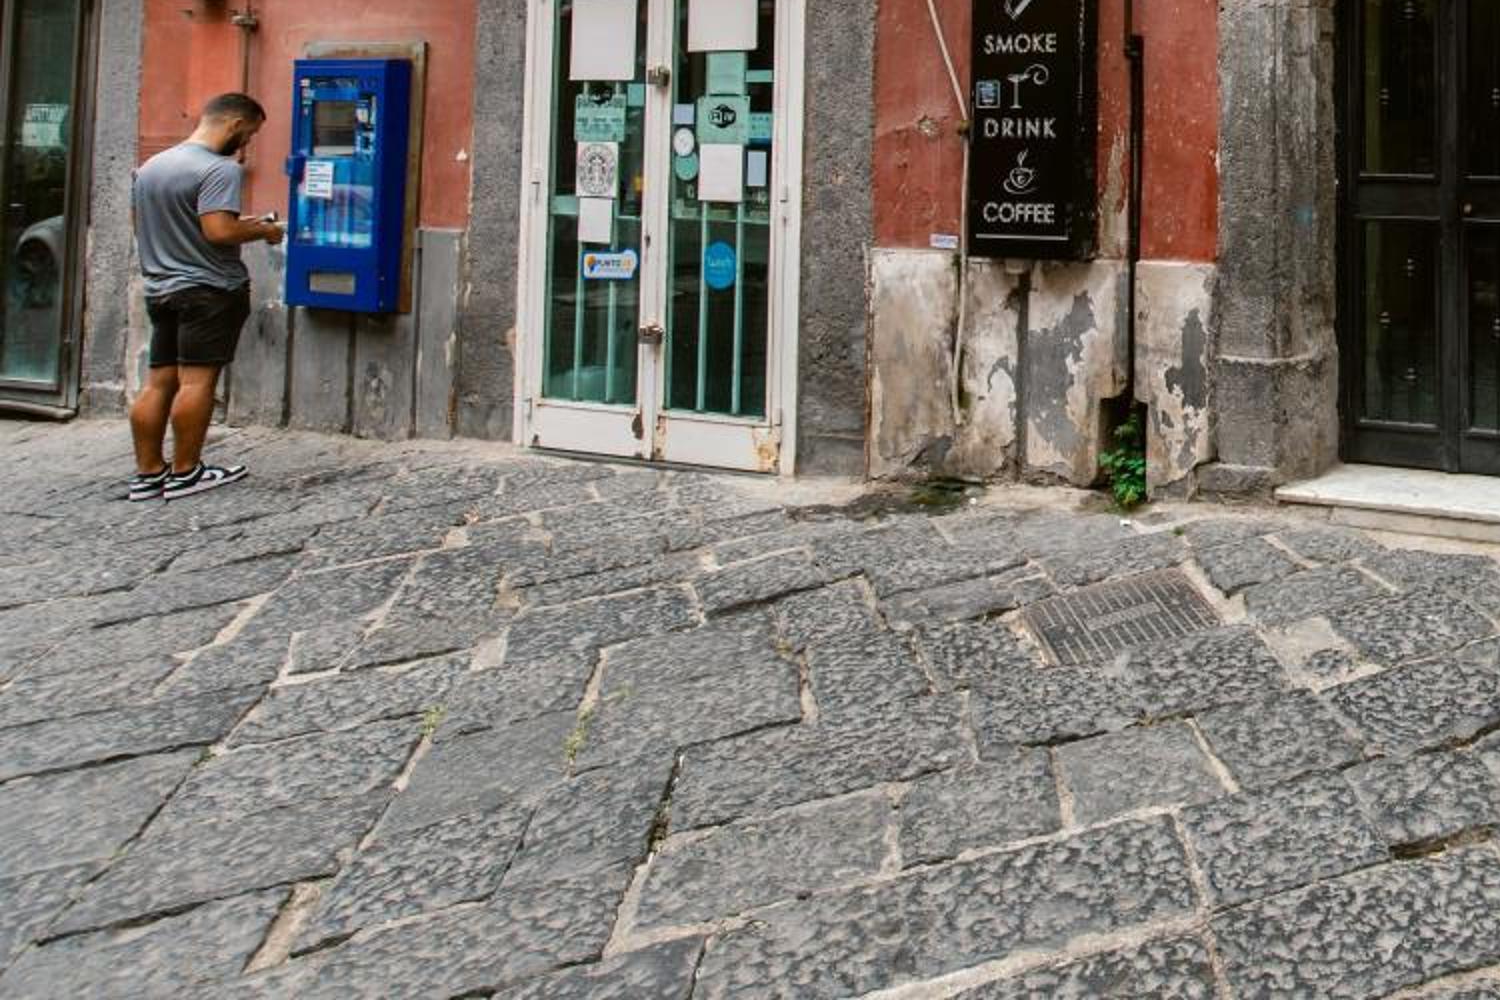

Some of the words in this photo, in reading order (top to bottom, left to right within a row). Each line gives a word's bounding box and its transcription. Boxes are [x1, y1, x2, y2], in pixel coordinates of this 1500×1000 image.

[983, 33, 1057, 54] SMOKE
[983, 117, 1057, 138] DRINK
[983, 202, 1055, 223] COFFEE
